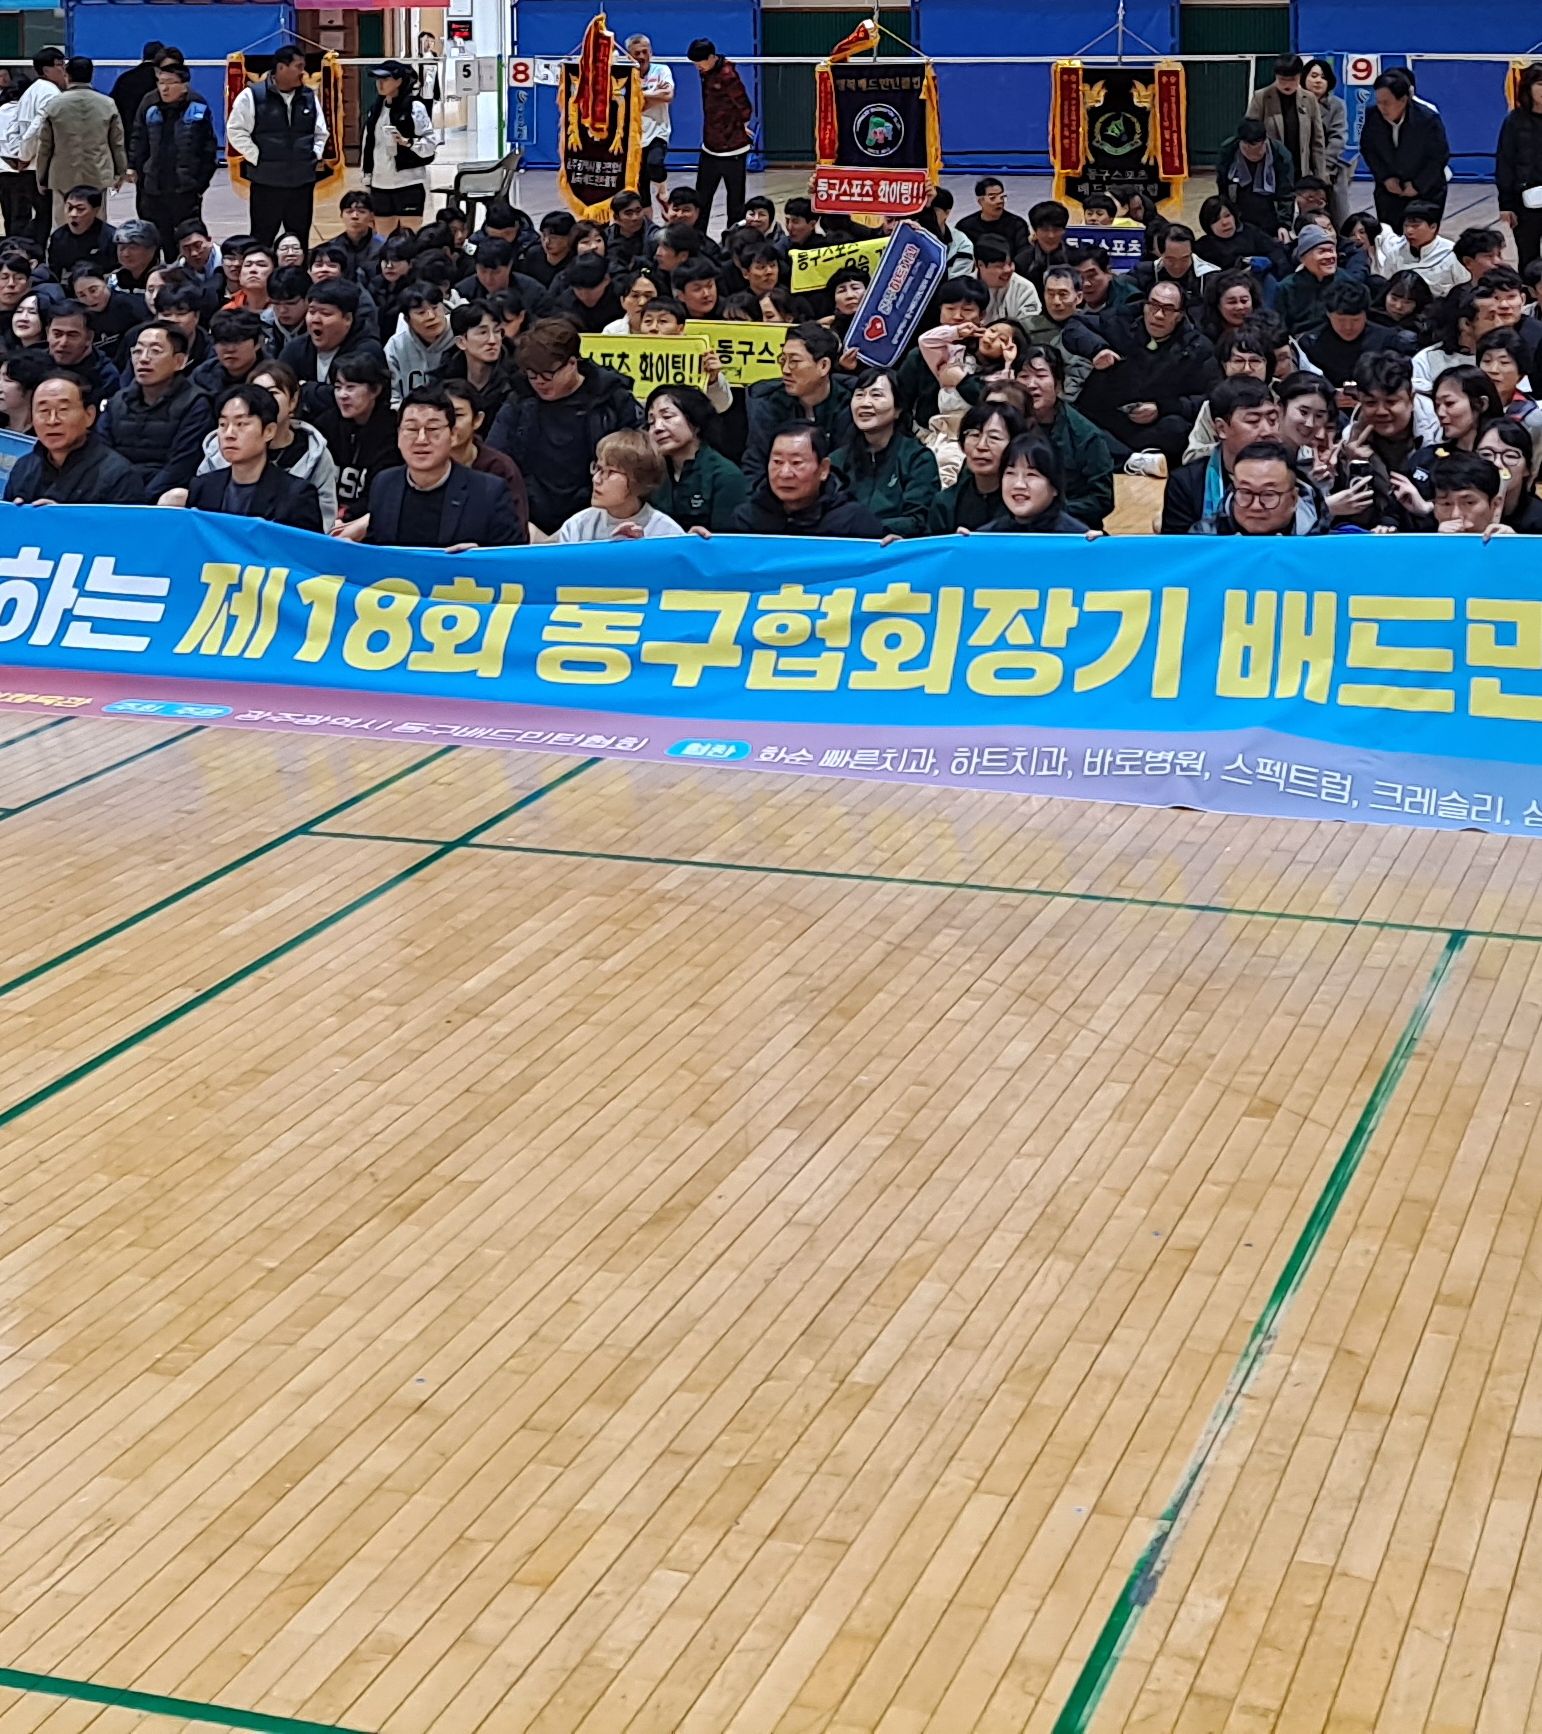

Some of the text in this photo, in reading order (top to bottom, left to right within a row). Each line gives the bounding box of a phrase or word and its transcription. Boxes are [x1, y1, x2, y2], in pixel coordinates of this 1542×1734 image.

[462, 63, 472, 78] 5
[512, 61, 530, 83] 8
[1352, 57, 1373, 81] 9
[817, 178, 924, 205] 동구스포츠 화이팅!!
[715, 339, 785, 365] 동구스
[639, 352, 703, 385] 화이팅!!
[173, 562, 524, 678] 제18회
[535, 582, 1189, 699] 동구협회장기
[233, 709, 393, 732] 광주광역시
[392, 721, 650, 753] 동구배드민턴협회
[755, 744, 814, 766] 화순
[818, 747, 941, 778] 빠른치과,
[949, 746, 1075, 779] 하트치과,
[1082, 750, 1212, 782] 바로병원,
[1219, 752, 1359, 810] 스펙트럼,
